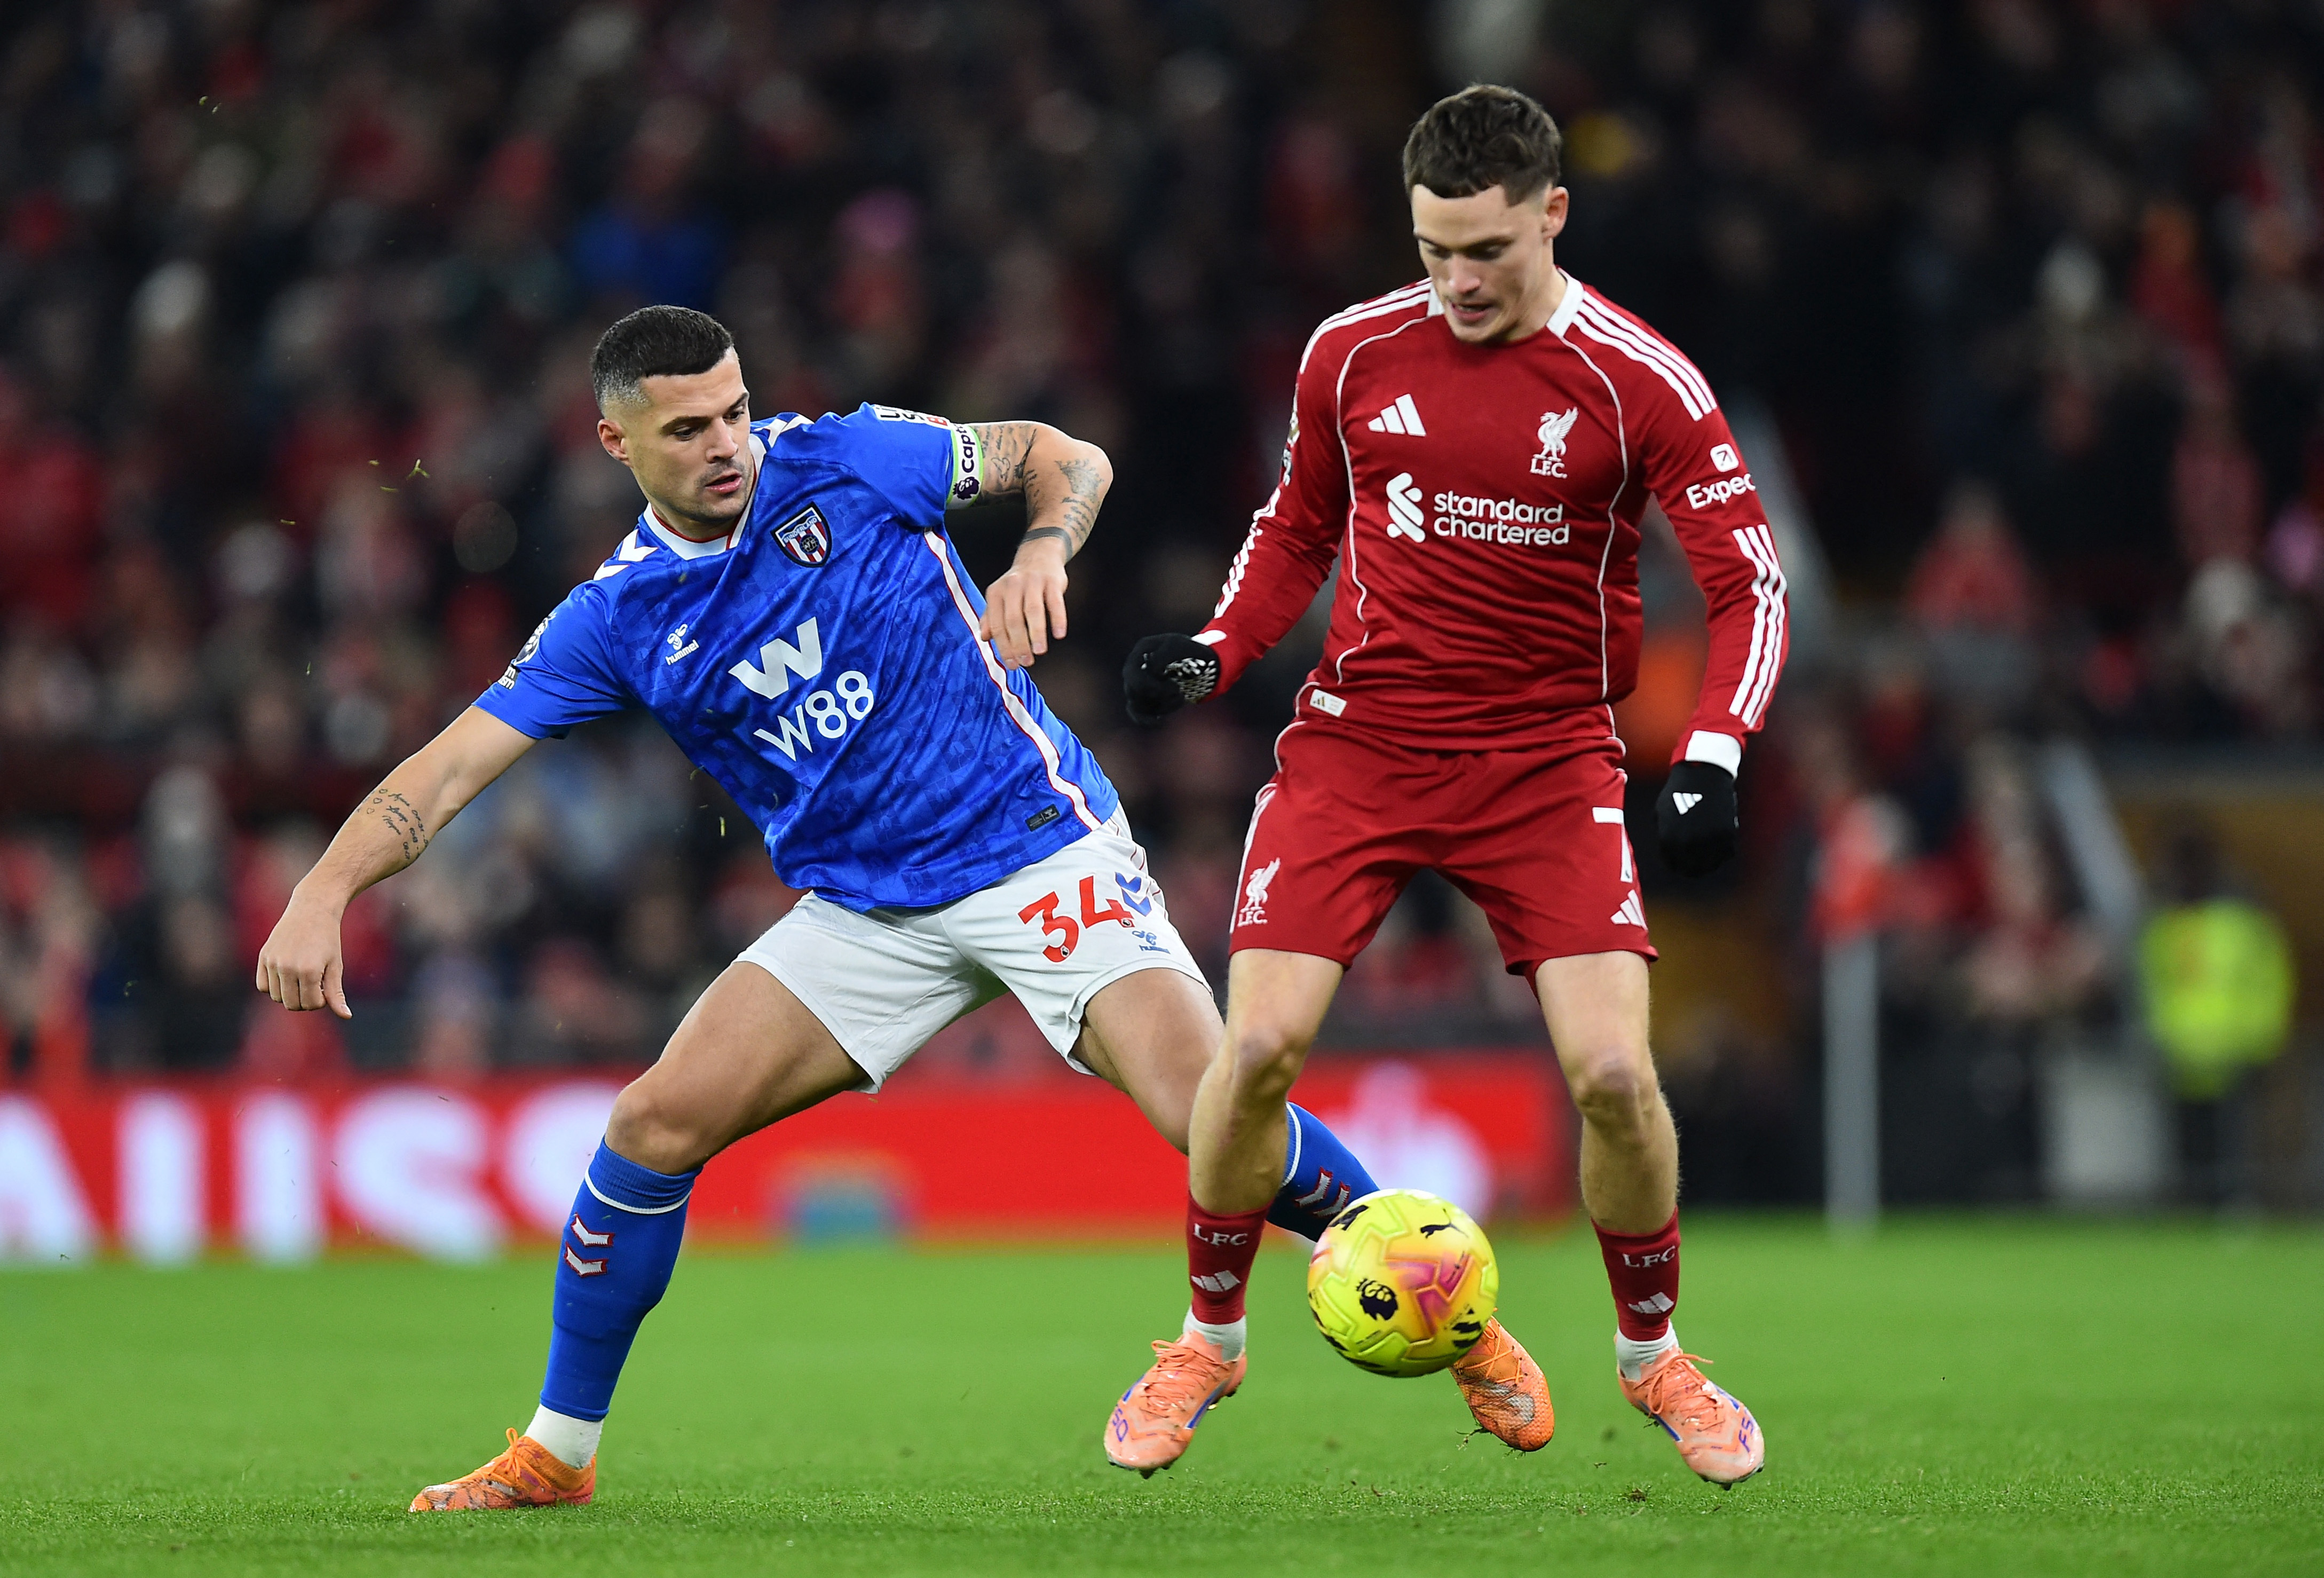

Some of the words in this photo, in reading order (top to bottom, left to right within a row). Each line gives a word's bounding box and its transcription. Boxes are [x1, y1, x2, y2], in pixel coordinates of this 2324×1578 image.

[1433, 490, 1563, 525] standard
[783, 517, 818, 543] SUNDERLAND
[1433, 515, 1570, 546] chartered
[665, 639, 700, 666] hummel
[753, 670, 874, 762] W88
[1592, 807, 1633, 884] 7
[1017, 875, 1136, 963] 34
[1193, 1222, 1248, 1247] LFC
[1622, 1245, 1676, 1268] LFC
